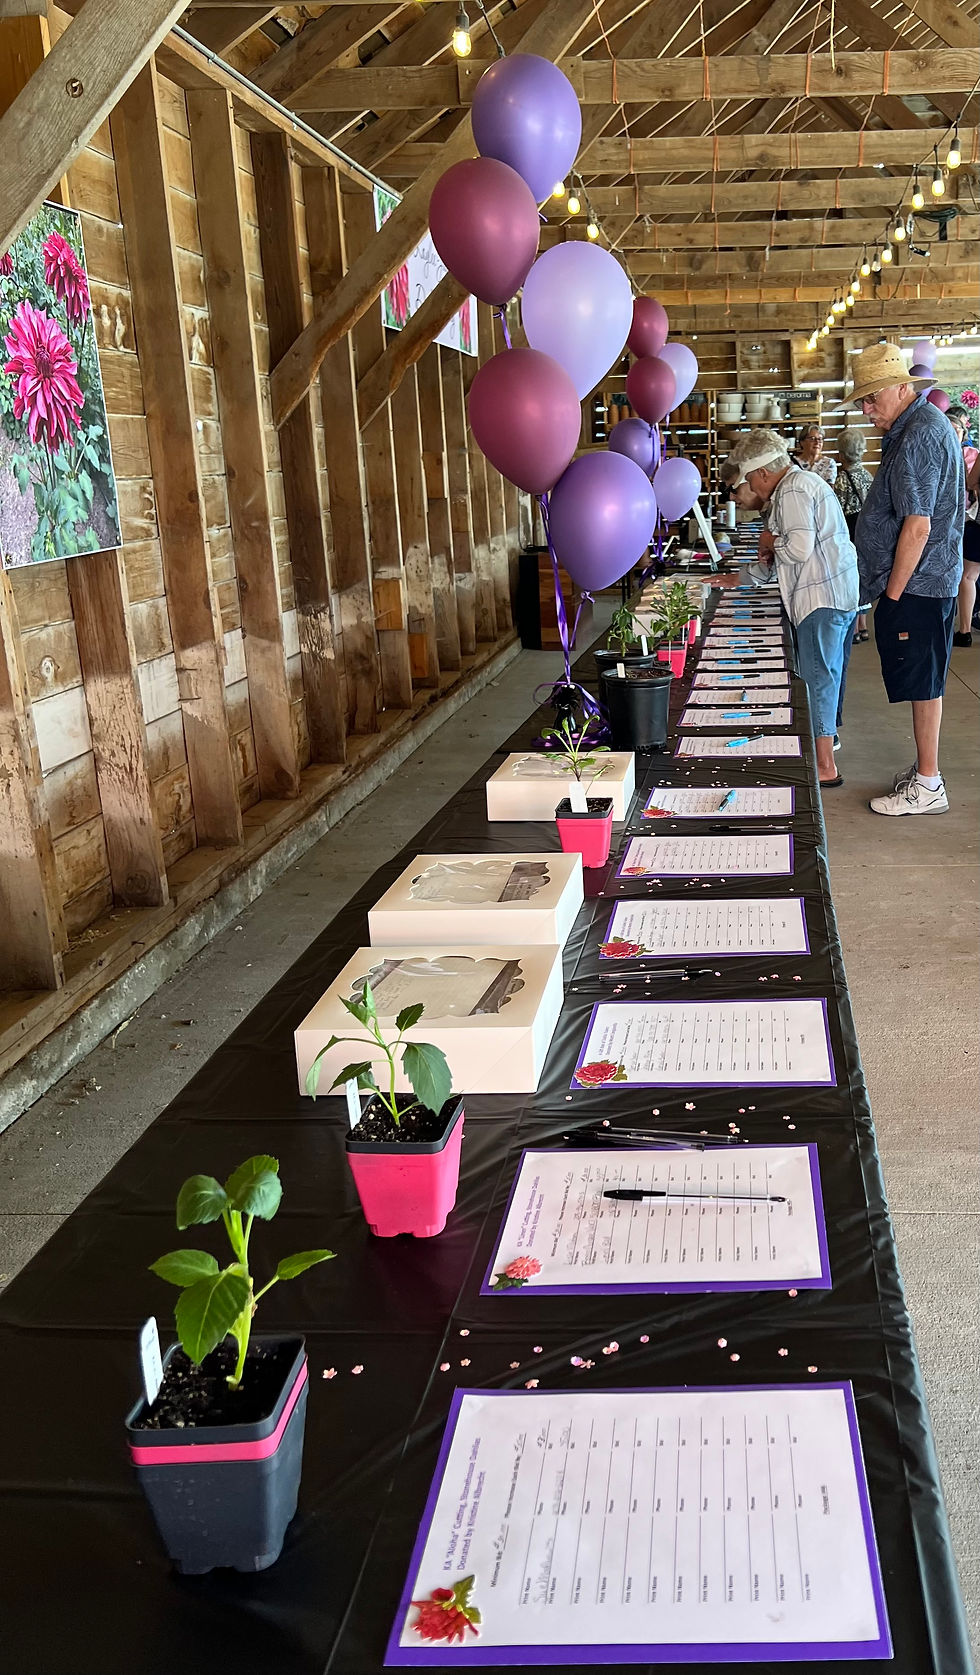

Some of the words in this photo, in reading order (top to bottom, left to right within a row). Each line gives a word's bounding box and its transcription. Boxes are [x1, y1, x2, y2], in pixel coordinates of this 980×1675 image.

[446, 1530, 461, 1558] "Aloha"
[464, 1528, 475, 1537] by
[443, 1560, 454, 1571] KA
[457, 1538, 472, 1570] Donated
[490, 1561, 501, 1587] Minimum
